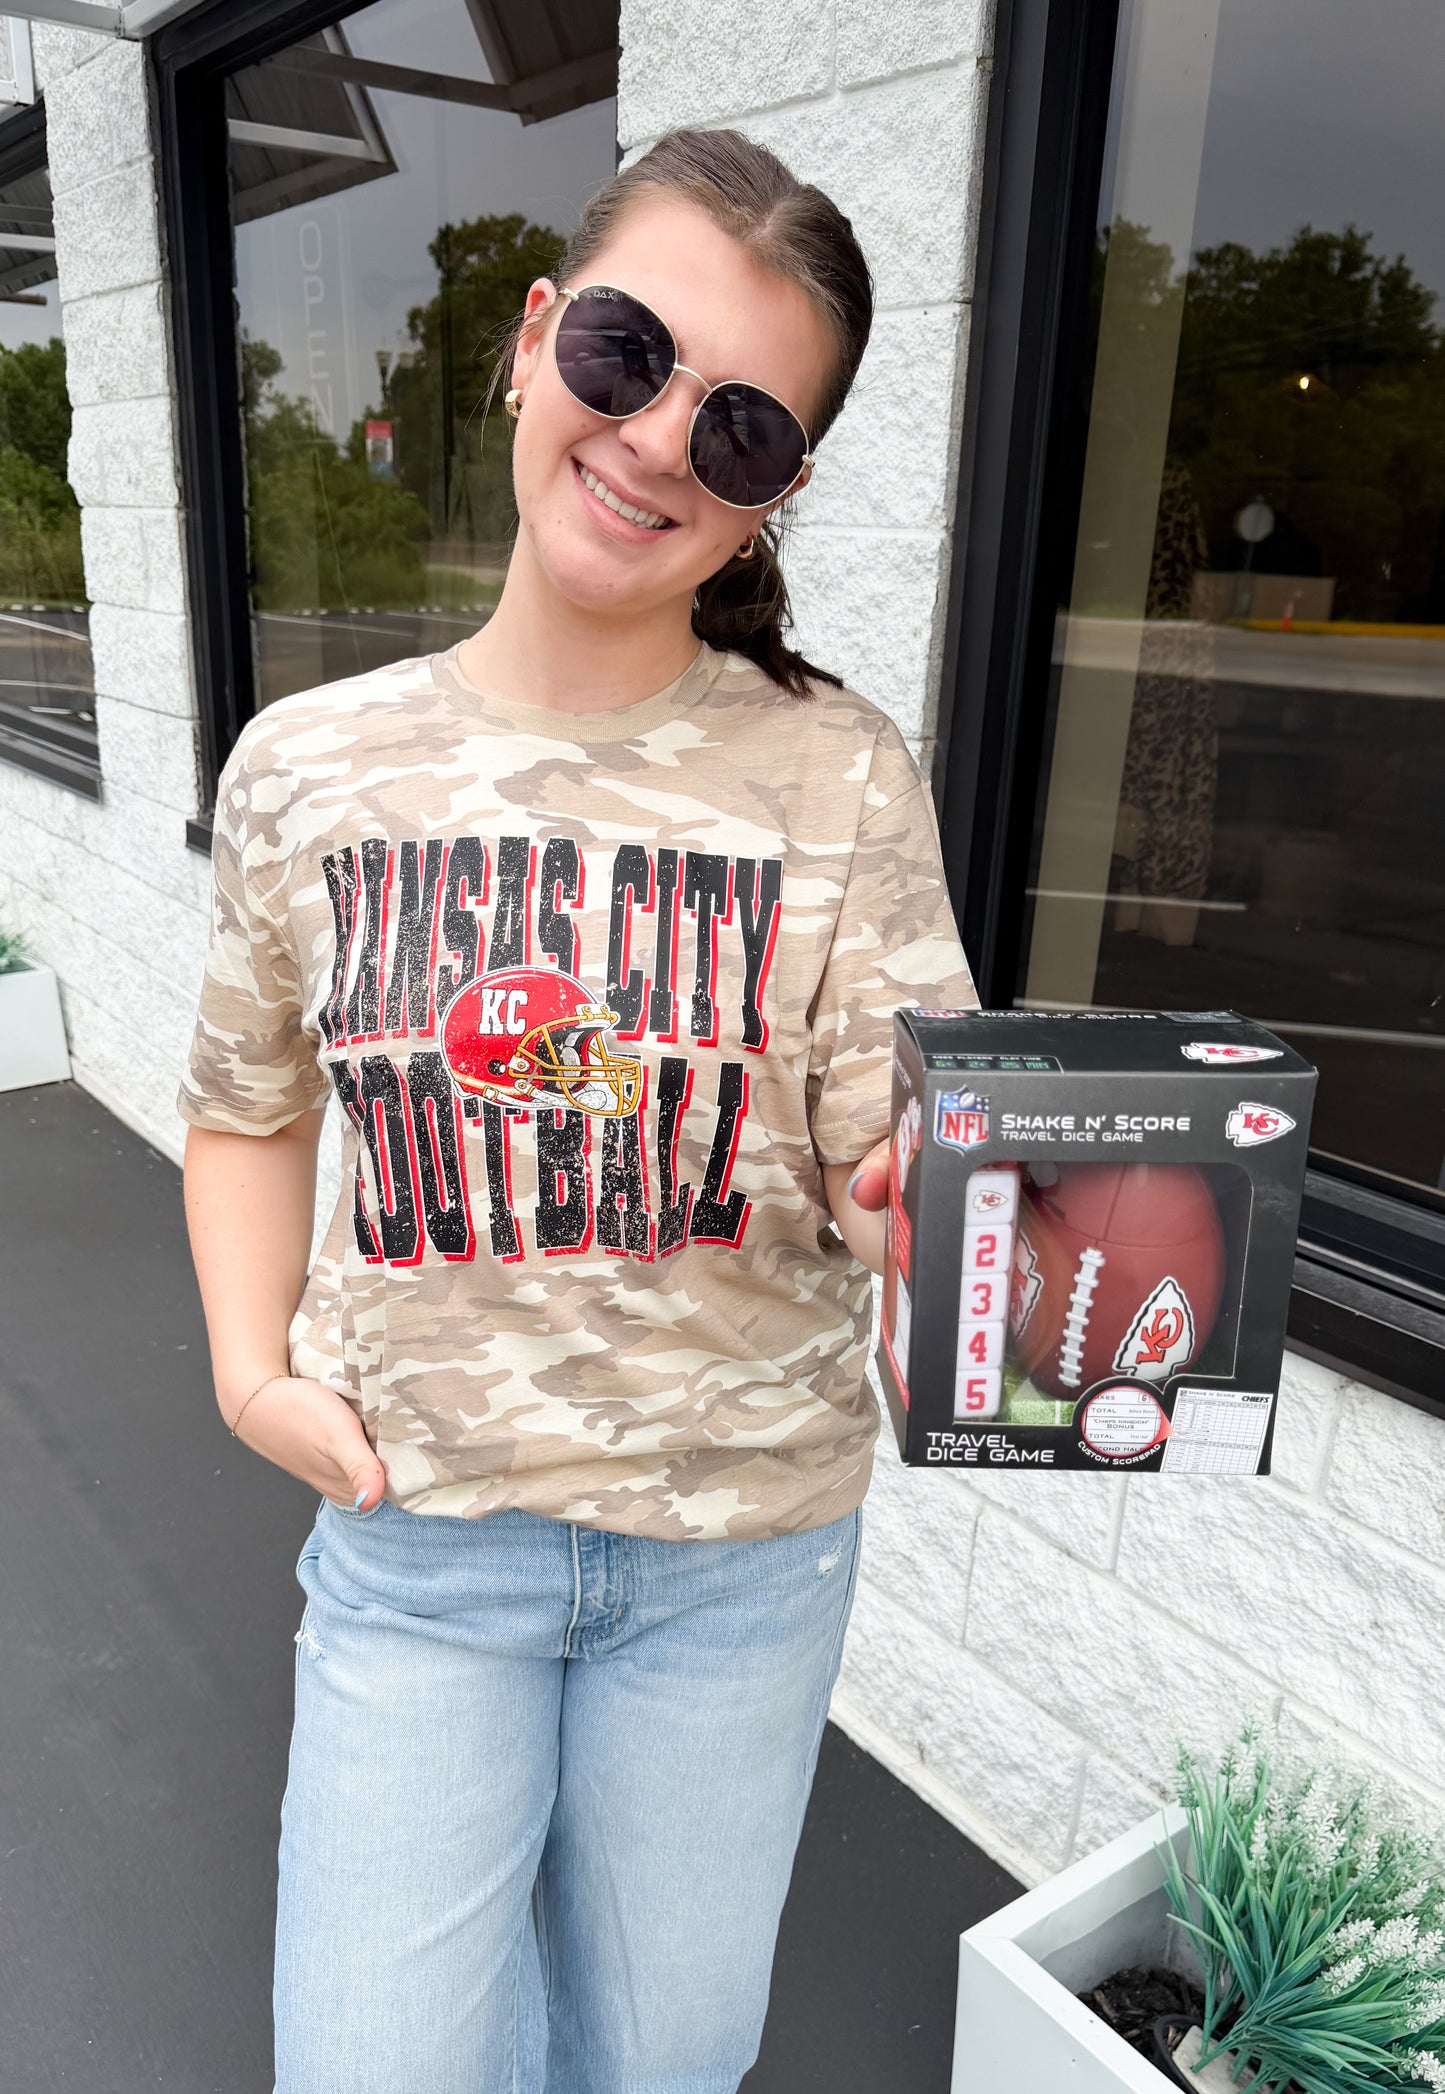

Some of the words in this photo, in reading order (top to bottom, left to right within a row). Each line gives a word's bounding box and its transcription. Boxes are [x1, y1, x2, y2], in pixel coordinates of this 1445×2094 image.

[300, 220, 335, 433] OPEN
[318, 835, 587, 1052] KANSAS
[605, 843, 785, 1056] CITY
[478, 987, 529, 1037] KC
[943, 1111, 990, 1146] NFL
[1000, 1131, 1056, 1142] TRAVEL
[1062, 1131, 1096, 1142] DICE
[1101, 1132, 1144, 1143] GAME
[1001, 1114, 1075, 1130] SHAKE
[1114, 1115, 1191, 1132] SCORE
[975, 1234, 997, 1268] 2
[971, 1283, 993, 1316] 3
[968, 1331, 988, 1363] 4
[965, 1378, 987, 1411] 5
[1241, 1395, 1270, 1403] CHIEFS
[926, 1432, 1015, 1449] TRAVEL
[1089, 1432, 1115, 1440] TOTAL
[926, 1447, 979, 1462] DICE
[989, 1449, 1055, 1463] GAME
[1077, 1440, 1110, 1464] CUSTOM
[1112, 1443, 1162, 1466] SCOREPAD
